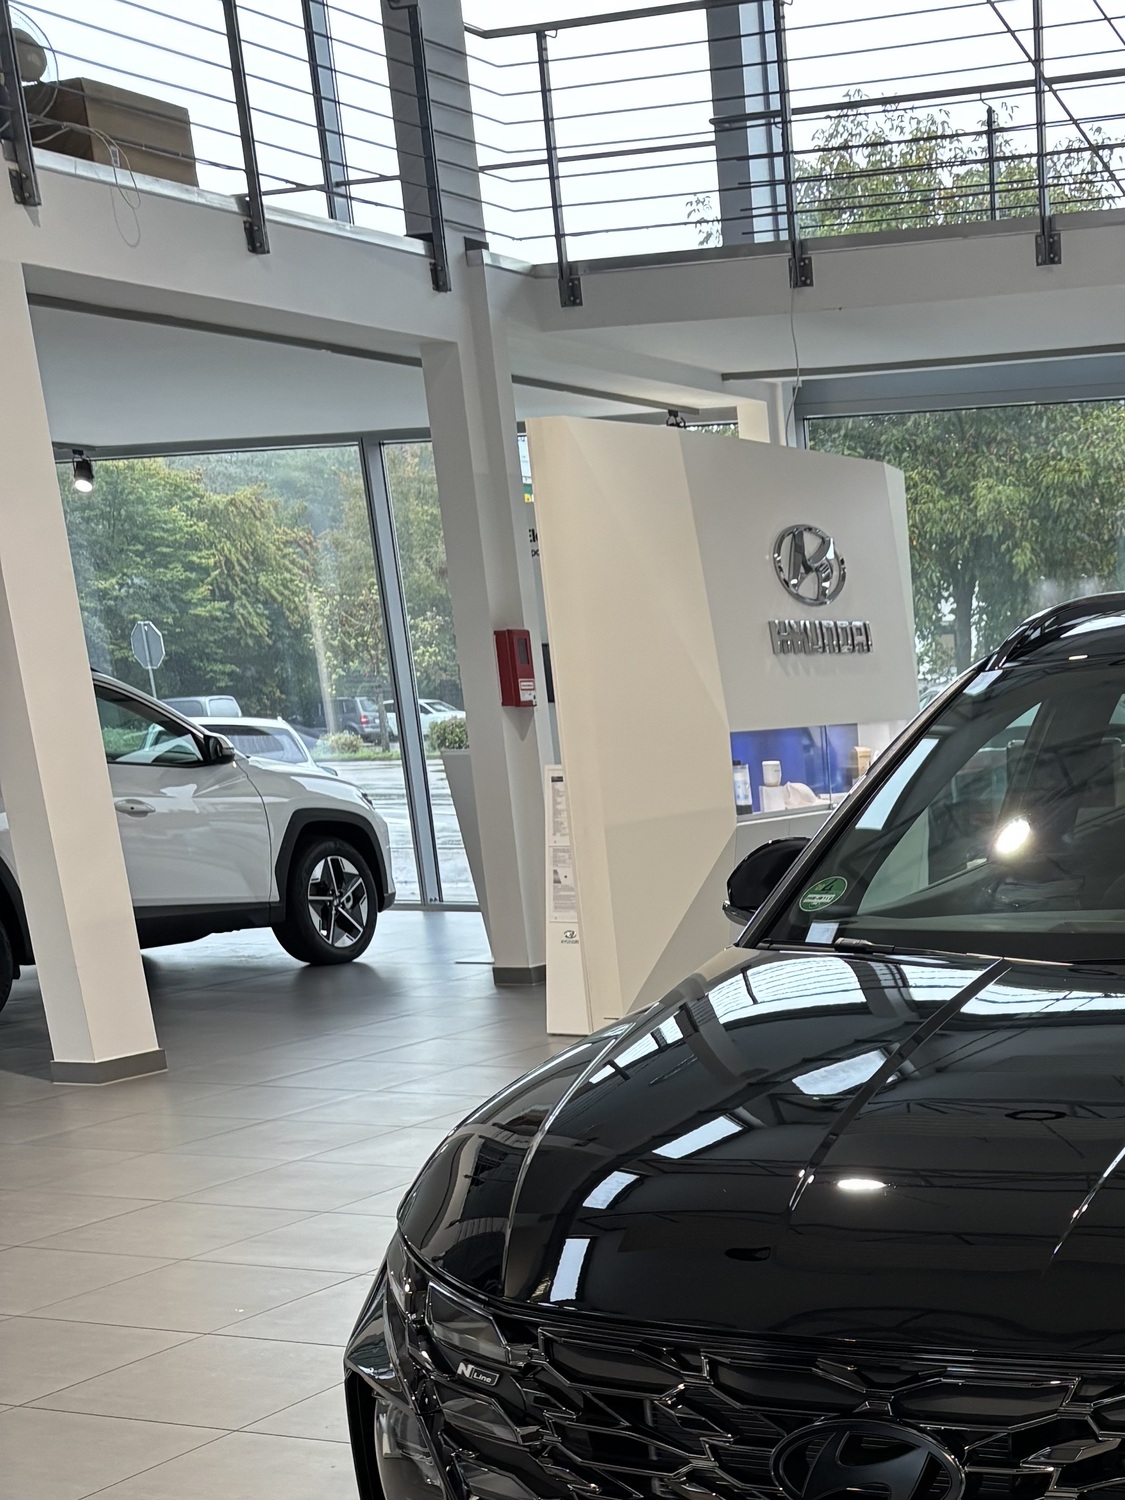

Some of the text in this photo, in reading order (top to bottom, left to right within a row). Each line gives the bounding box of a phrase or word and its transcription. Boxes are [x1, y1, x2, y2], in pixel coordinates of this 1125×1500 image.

[768, 619, 873, 655] HYUNDAI
[457, 1362, 492, 1383] N Line
